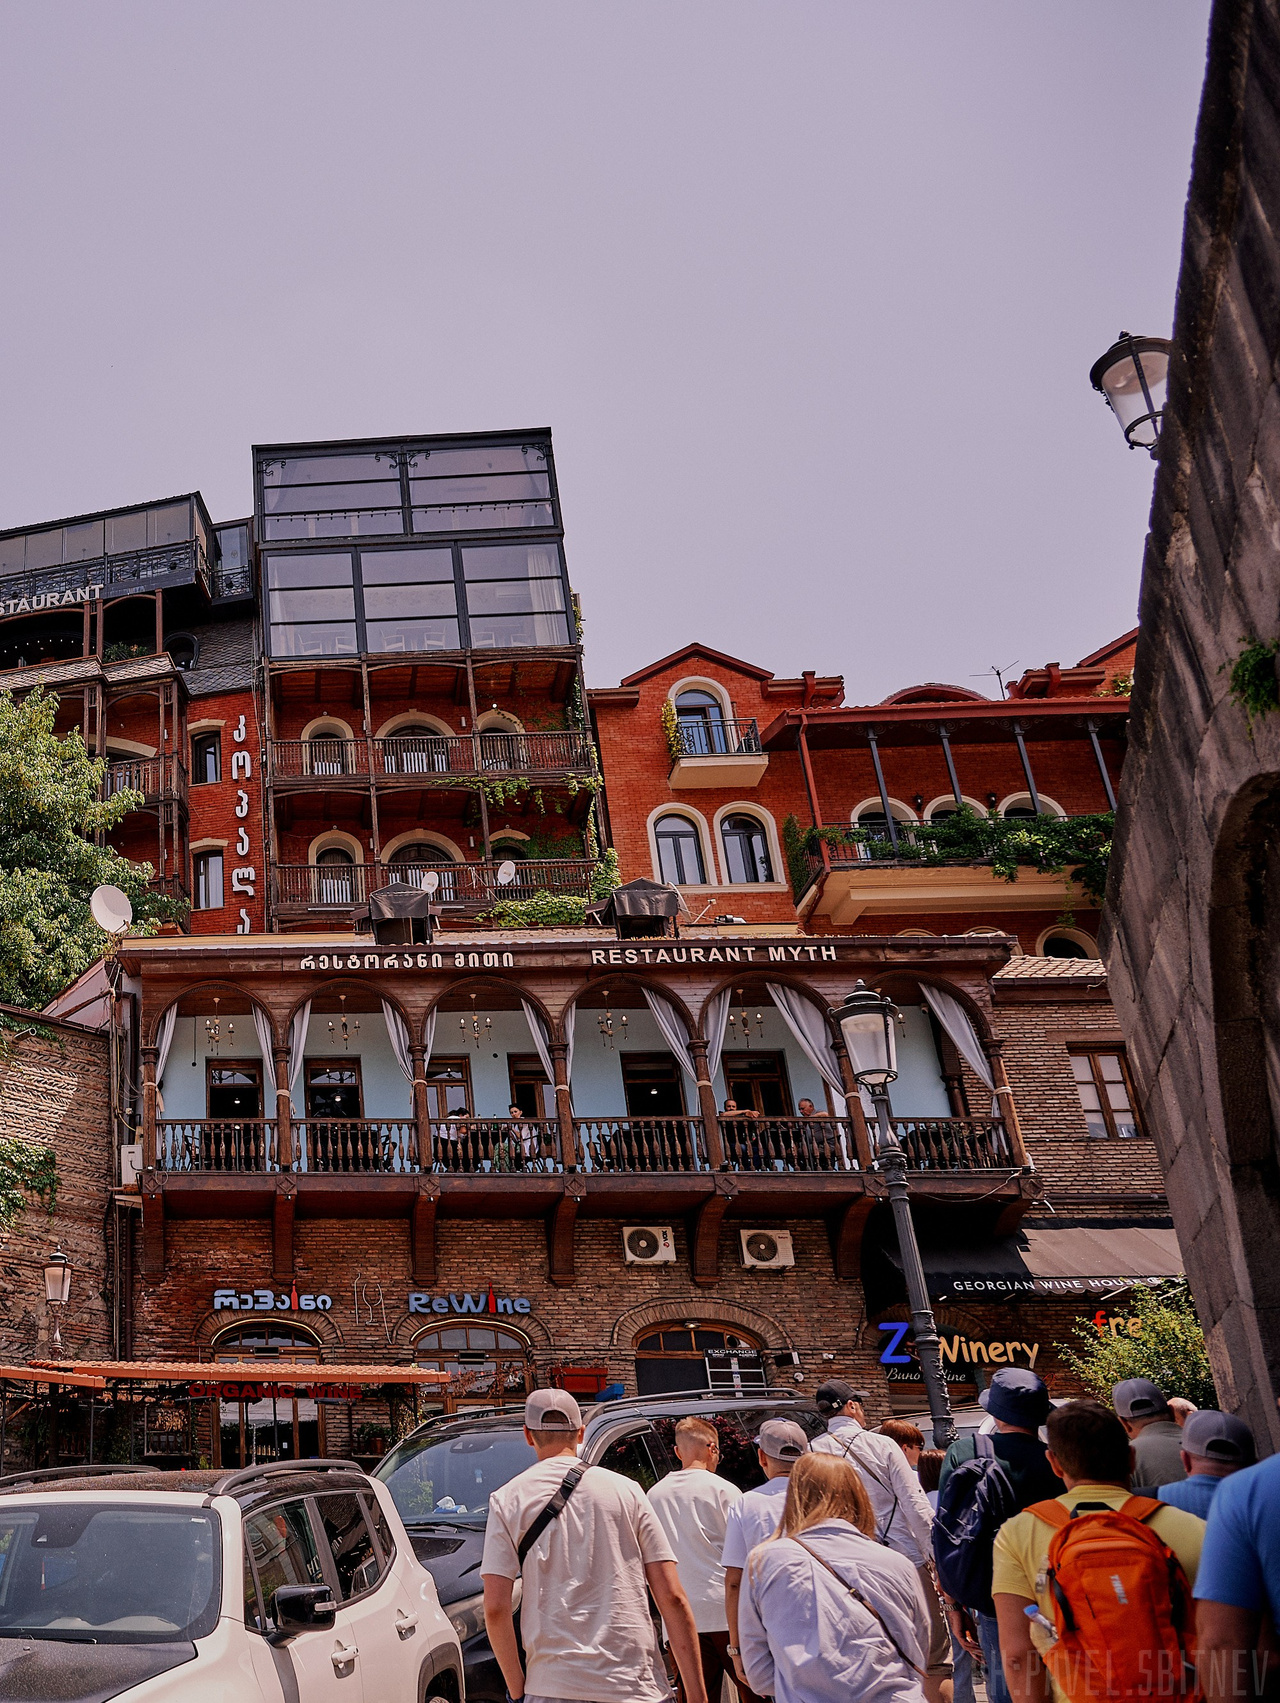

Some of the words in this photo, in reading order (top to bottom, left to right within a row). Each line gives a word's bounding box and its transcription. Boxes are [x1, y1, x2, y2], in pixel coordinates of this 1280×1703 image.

[231, 714, 256, 934] კოპალა
[300, 953, 443, 970] რესტორანი
[454, 952, 514, 968] მითი
[591, 947, 756, 964] RESTAURANT
[769, 946, 837, 962] MYTH
[953, 1280, 1035, 1291] GEORGIAN
[1039, 1280, 1083, 1289] WINE
[1089, 1278, 1142, 1287] HOUSE
[408, 1282, 531, 1314] ReWine
[878, 1322, 912, 1364] Z
[188, 1384, 295, 1398] ORGANIC
[306, 1385, 363, 1399] WINE
